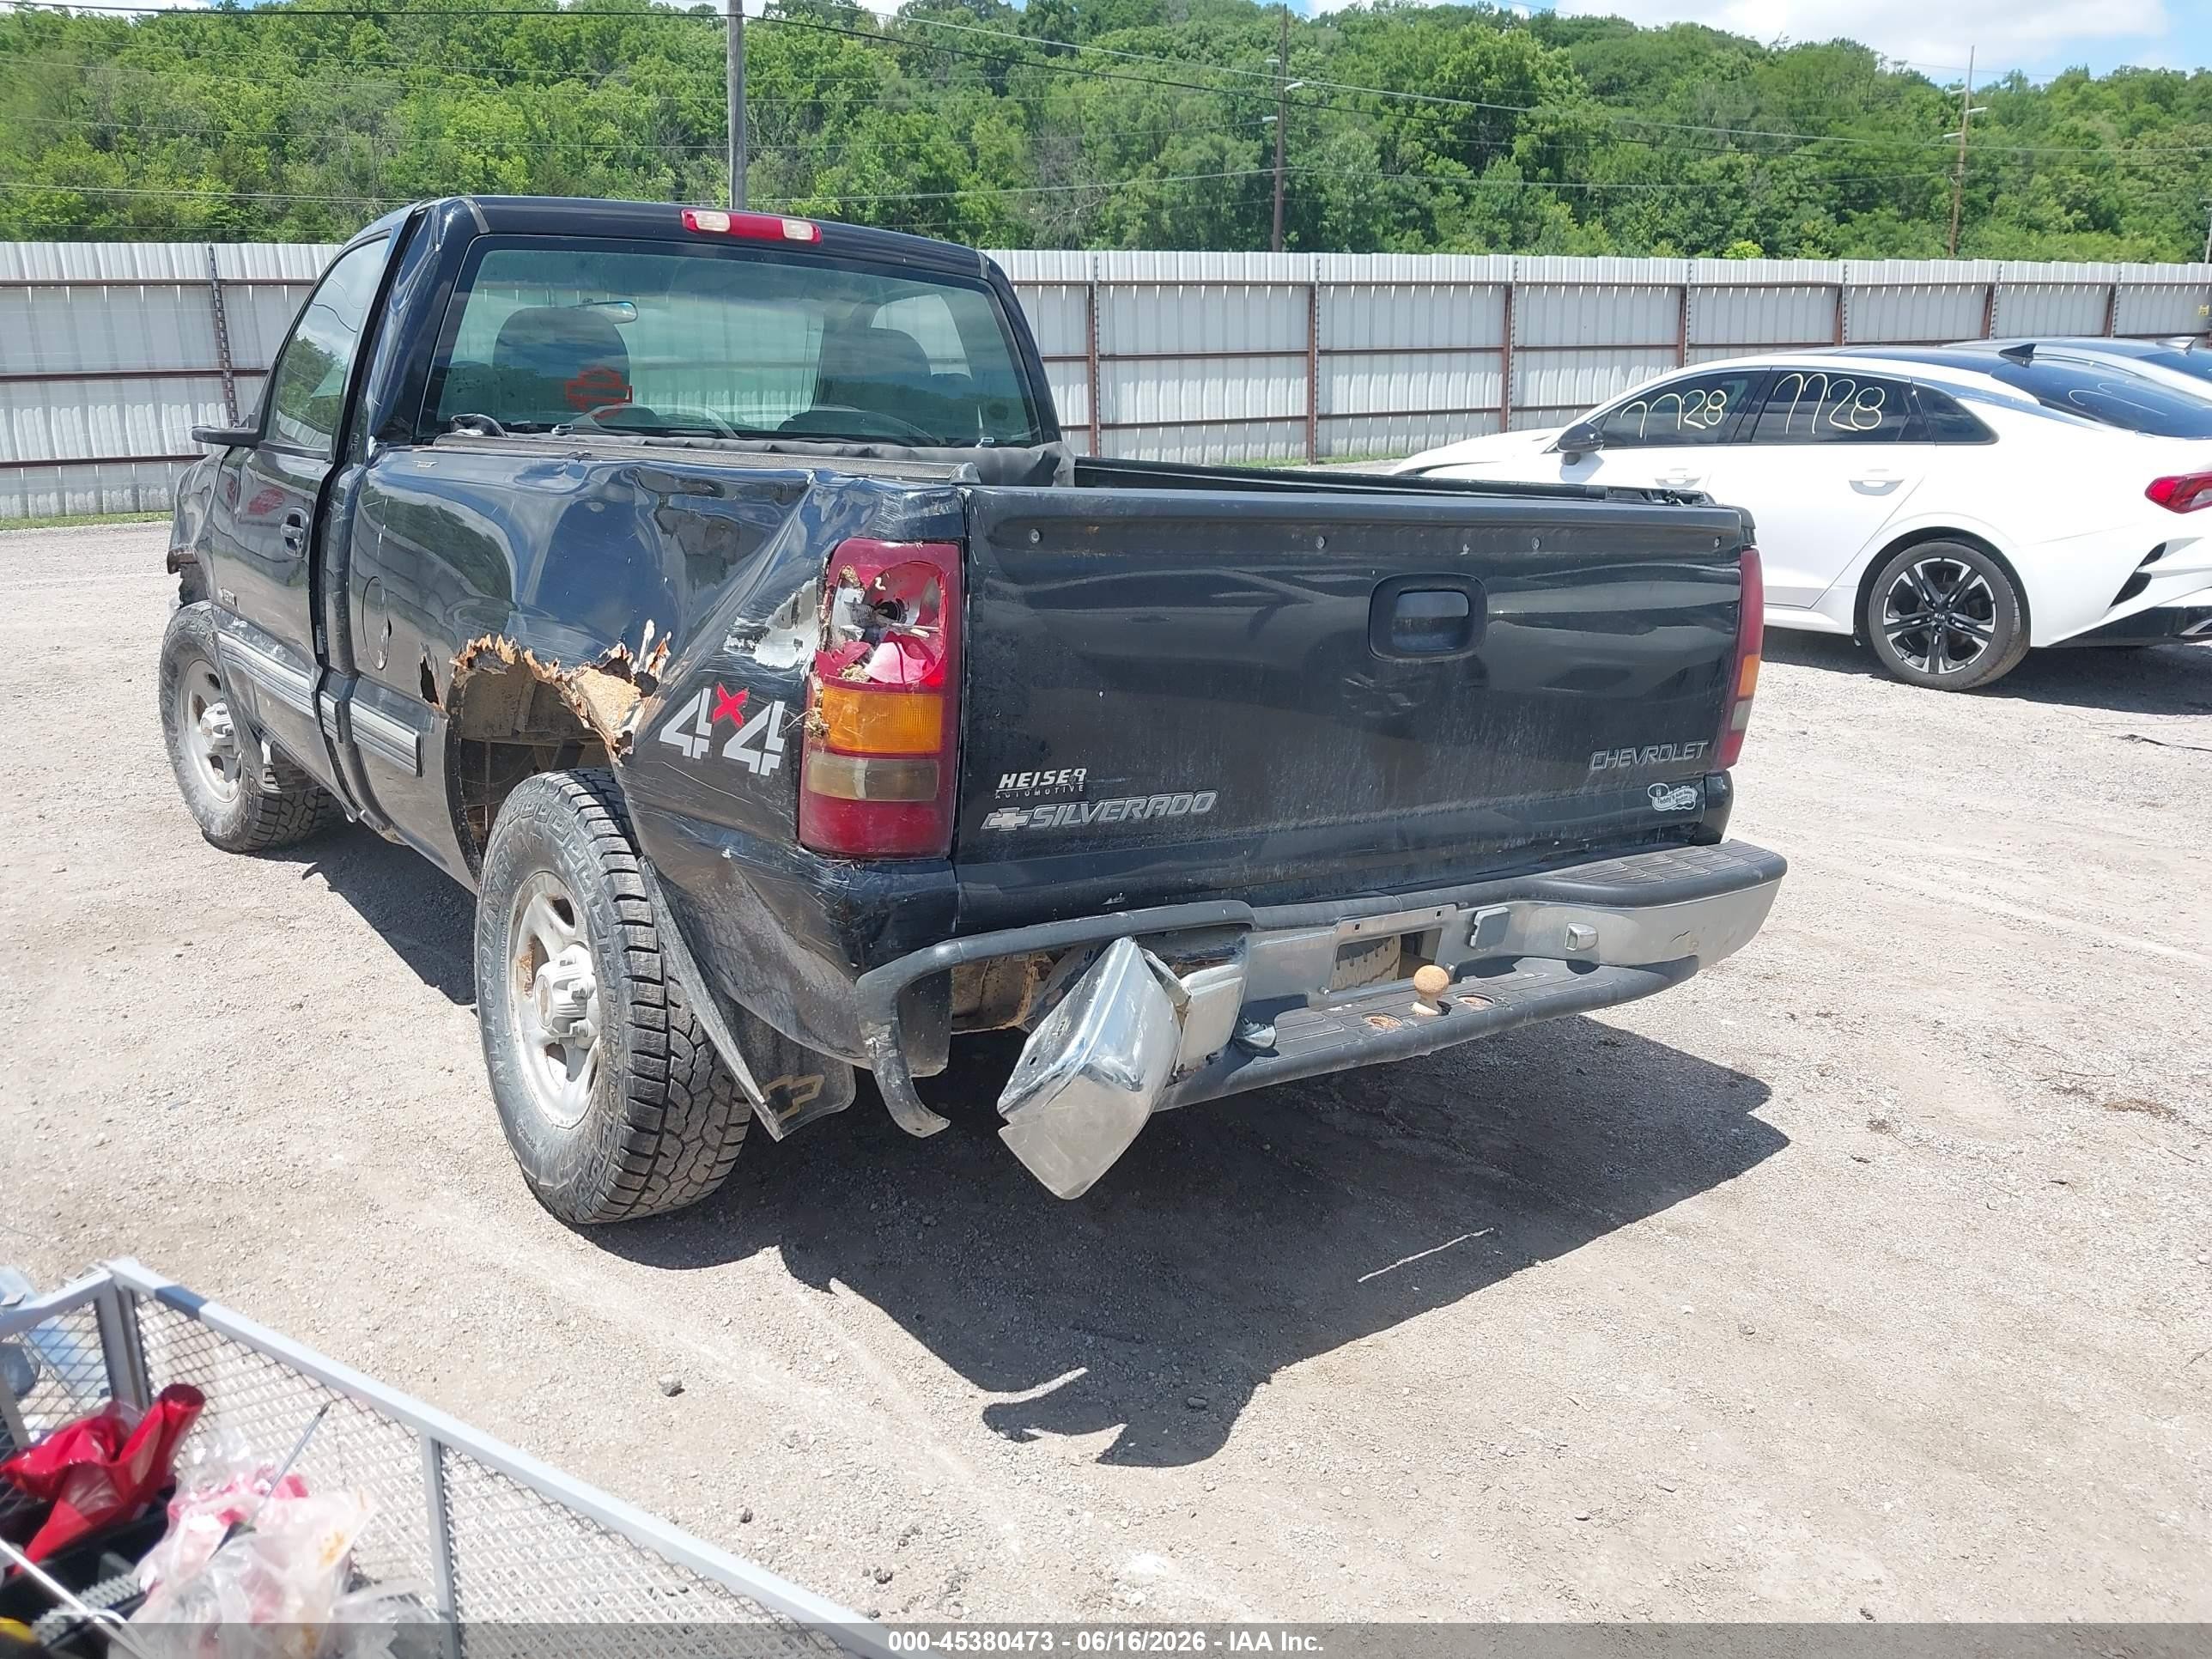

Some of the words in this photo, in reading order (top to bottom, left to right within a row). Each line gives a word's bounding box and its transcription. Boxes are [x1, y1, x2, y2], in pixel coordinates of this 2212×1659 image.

[1589, 740, 1709, 770] CHEVROLET
[998, 768, 1087, 789] HEISER
[994, 784, 1085, 799] AUTOMOTIVE
[1029, 790, 1218, 829] SILVERADO
